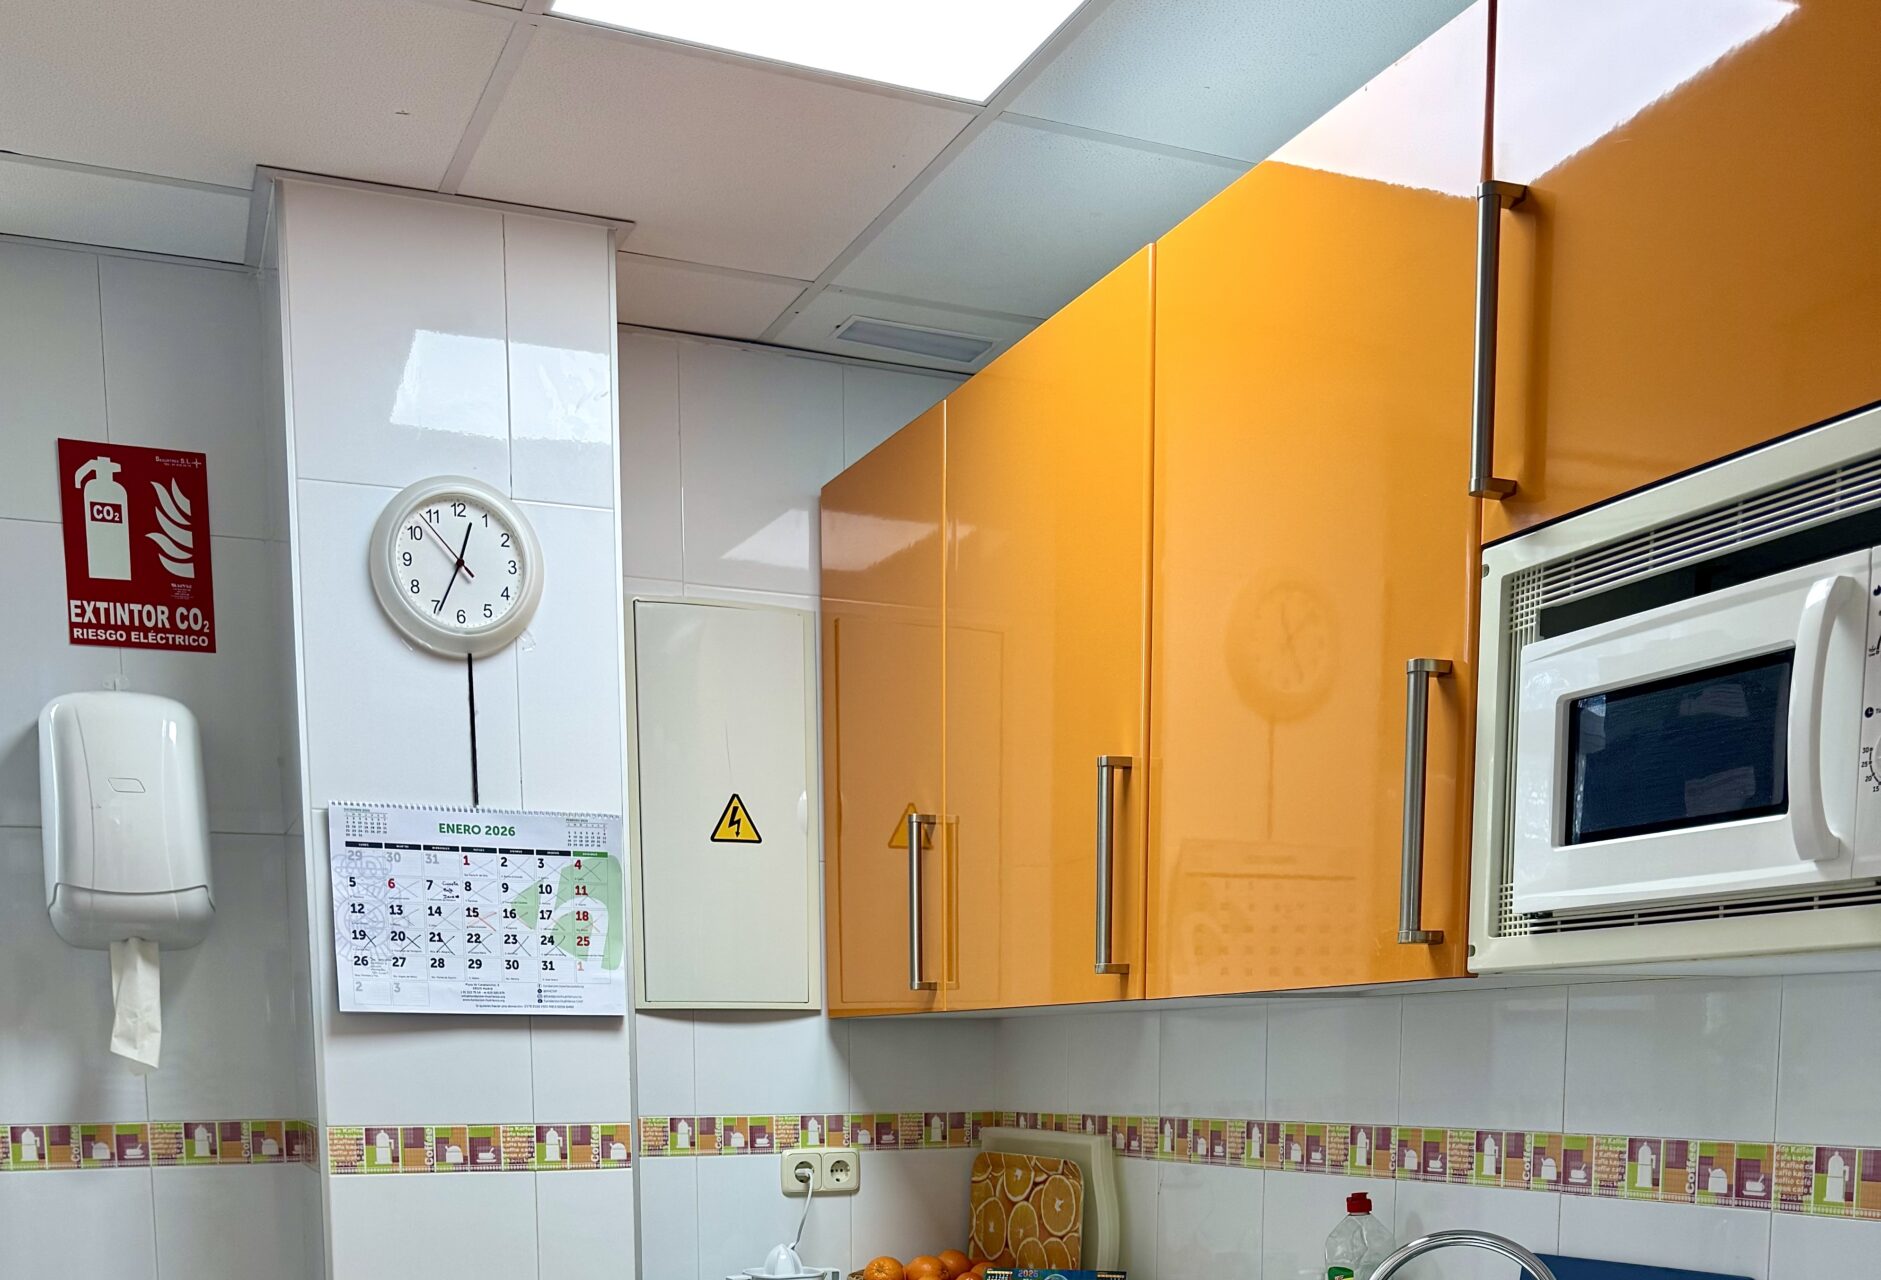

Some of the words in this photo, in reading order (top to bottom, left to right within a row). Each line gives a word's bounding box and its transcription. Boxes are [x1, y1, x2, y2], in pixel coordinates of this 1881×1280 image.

[426, 509, 440, 524] 11
[451, 503, 466, 518] 12
[482, 513, 488, 528] 1
[407, 526, 422, 540] 10
[501, 533, 510, 548] 2
[402, 552, 412, 566] 9
[508, 560, 517, 574] 3
[410, 579, 420, 594] 8
[500, 586, 510, 600] 4
[69, 600, 170, 628] EXTINTOR
[431, 600, 440, 614] 7
[484, 604, 492, 618] 5
[456, 610, 466, 624] 6
[73, 628, 126, 642] RIESGO
[131, 630, 209, 647] ELÉCTRICO
[439, 823, 481, 835] ENERO
[484, 825, 516, 836] 2026
[348, 850, 362, 860] 29
[386, 852, 401, 862] 30
[426, 854, 439, 864] 31
[464, 855, 470, 865] 1
[500, 857, 508, 867] 2
[538, 858, 544, 868] 3
[574, 860, 582, 870] 4
[349, 876, 356, 887] 5
[388, 878, 396, 888] 6
[426, 880, 433, 890] 7
[464, 881, 472, 891] 8
[502, 883, 509, 892] 9
[538, 884, 552, 894] 10
[575, 885, 588, 895] 11
[350, 903, 364, 913] 12
[390, 905, 403, 915] 13
[428, 906, 442, 916] 14
[466, 907, 479, 918] 15
[503, 908, 516, 918] 16
[540, 910, 552, 920] 17
[576, 911, 589, 921] 18
[352, 930, 366, 940] 19
[391, 931, 406, 941] 20
[429, 932, 443, 942] 21
[467, 933, 481, 943] 22
[504, 934, 518, 944] 23
[540, 935, 555, 945] 24
[577, 936, 590, 946] 25
[354, 956, 368, 966] 26
[392, 957, 406, 967] 27
[431, 958, 445, 968] 28
[468, 959, 482, 969] 29
[505, 960, 519, 970] 30
[542, 961, 555, 970] 31
[578, 962, 584, 971] 1
[356, 982, 363, 991] 2
[394, 983, 400, 992] 3
[424, 1128, 434, 1165] Coffee
[591, 1126, 600, 1162] Coffee
[1522, 1135, 1532, 1180] Coffee
[1685, 1142, 1696, 1194] Coffee
